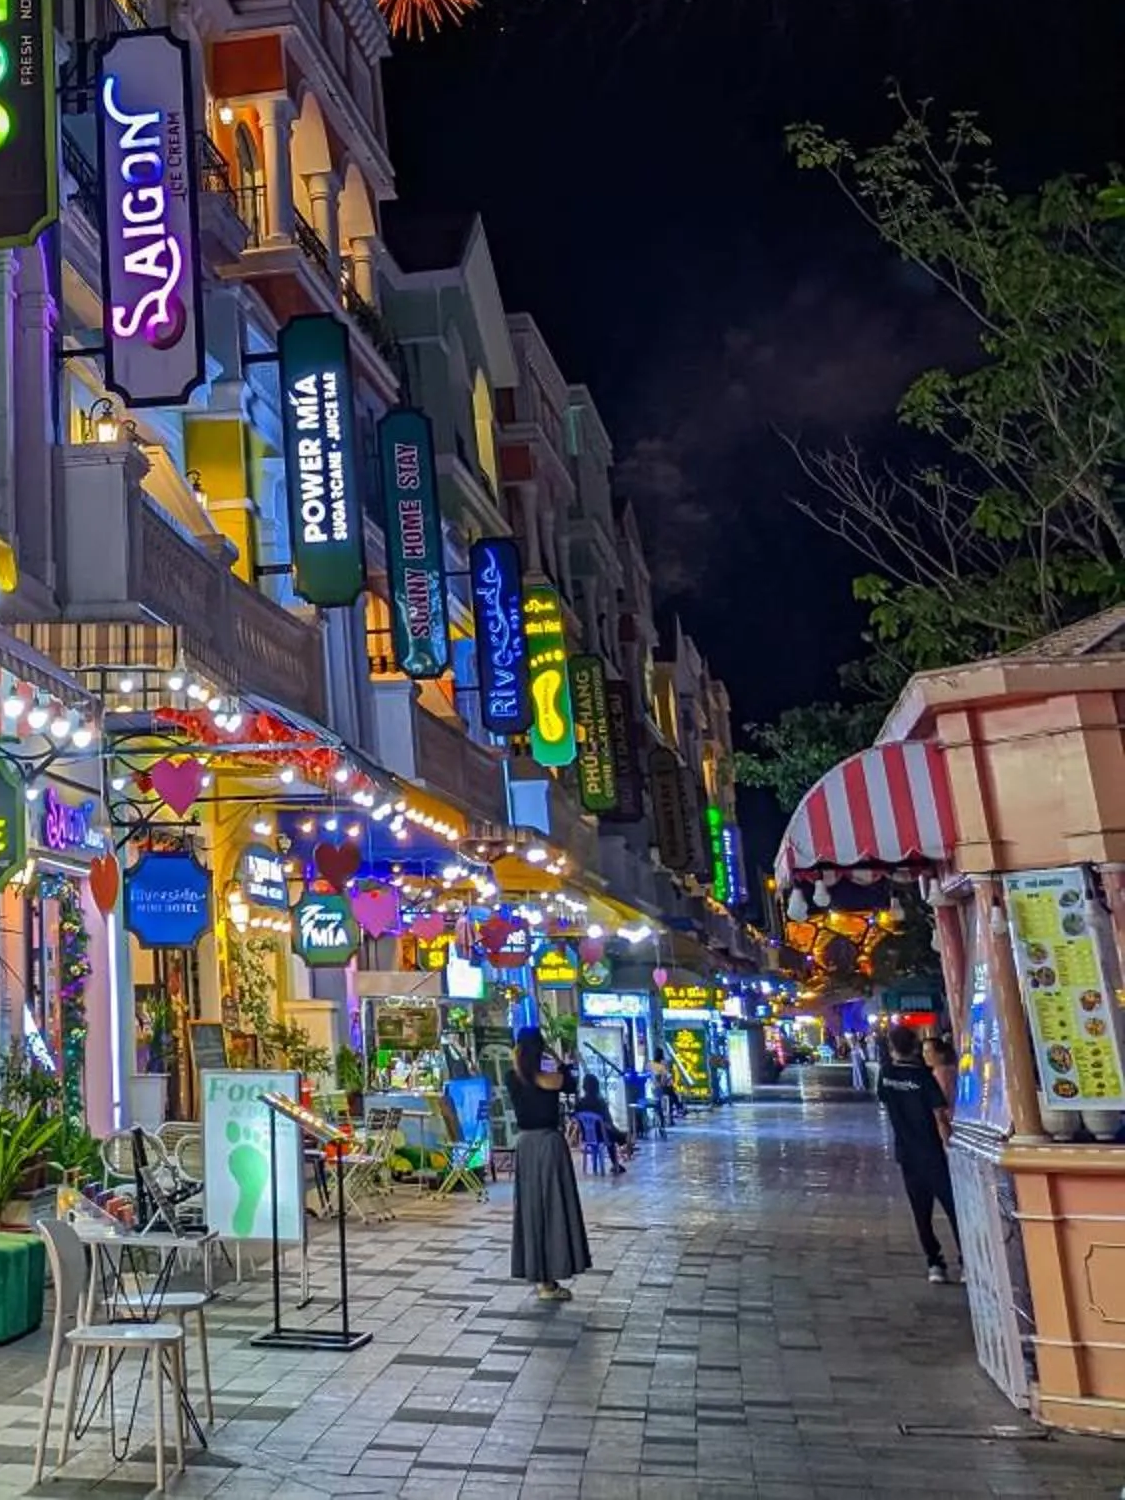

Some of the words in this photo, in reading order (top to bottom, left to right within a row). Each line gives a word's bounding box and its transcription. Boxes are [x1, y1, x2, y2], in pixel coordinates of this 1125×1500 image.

[20, 34, 35, 86] FRESH
[104, 75, 186, 350] SAIGON
[290, 374, 319, 431] MÍA
[299, 437, 329, 544] POWER
[395, 443, 419, 489] STAY
[398, 500, 426, 559] HOME
[311, 921, 348, 947] MÍA
